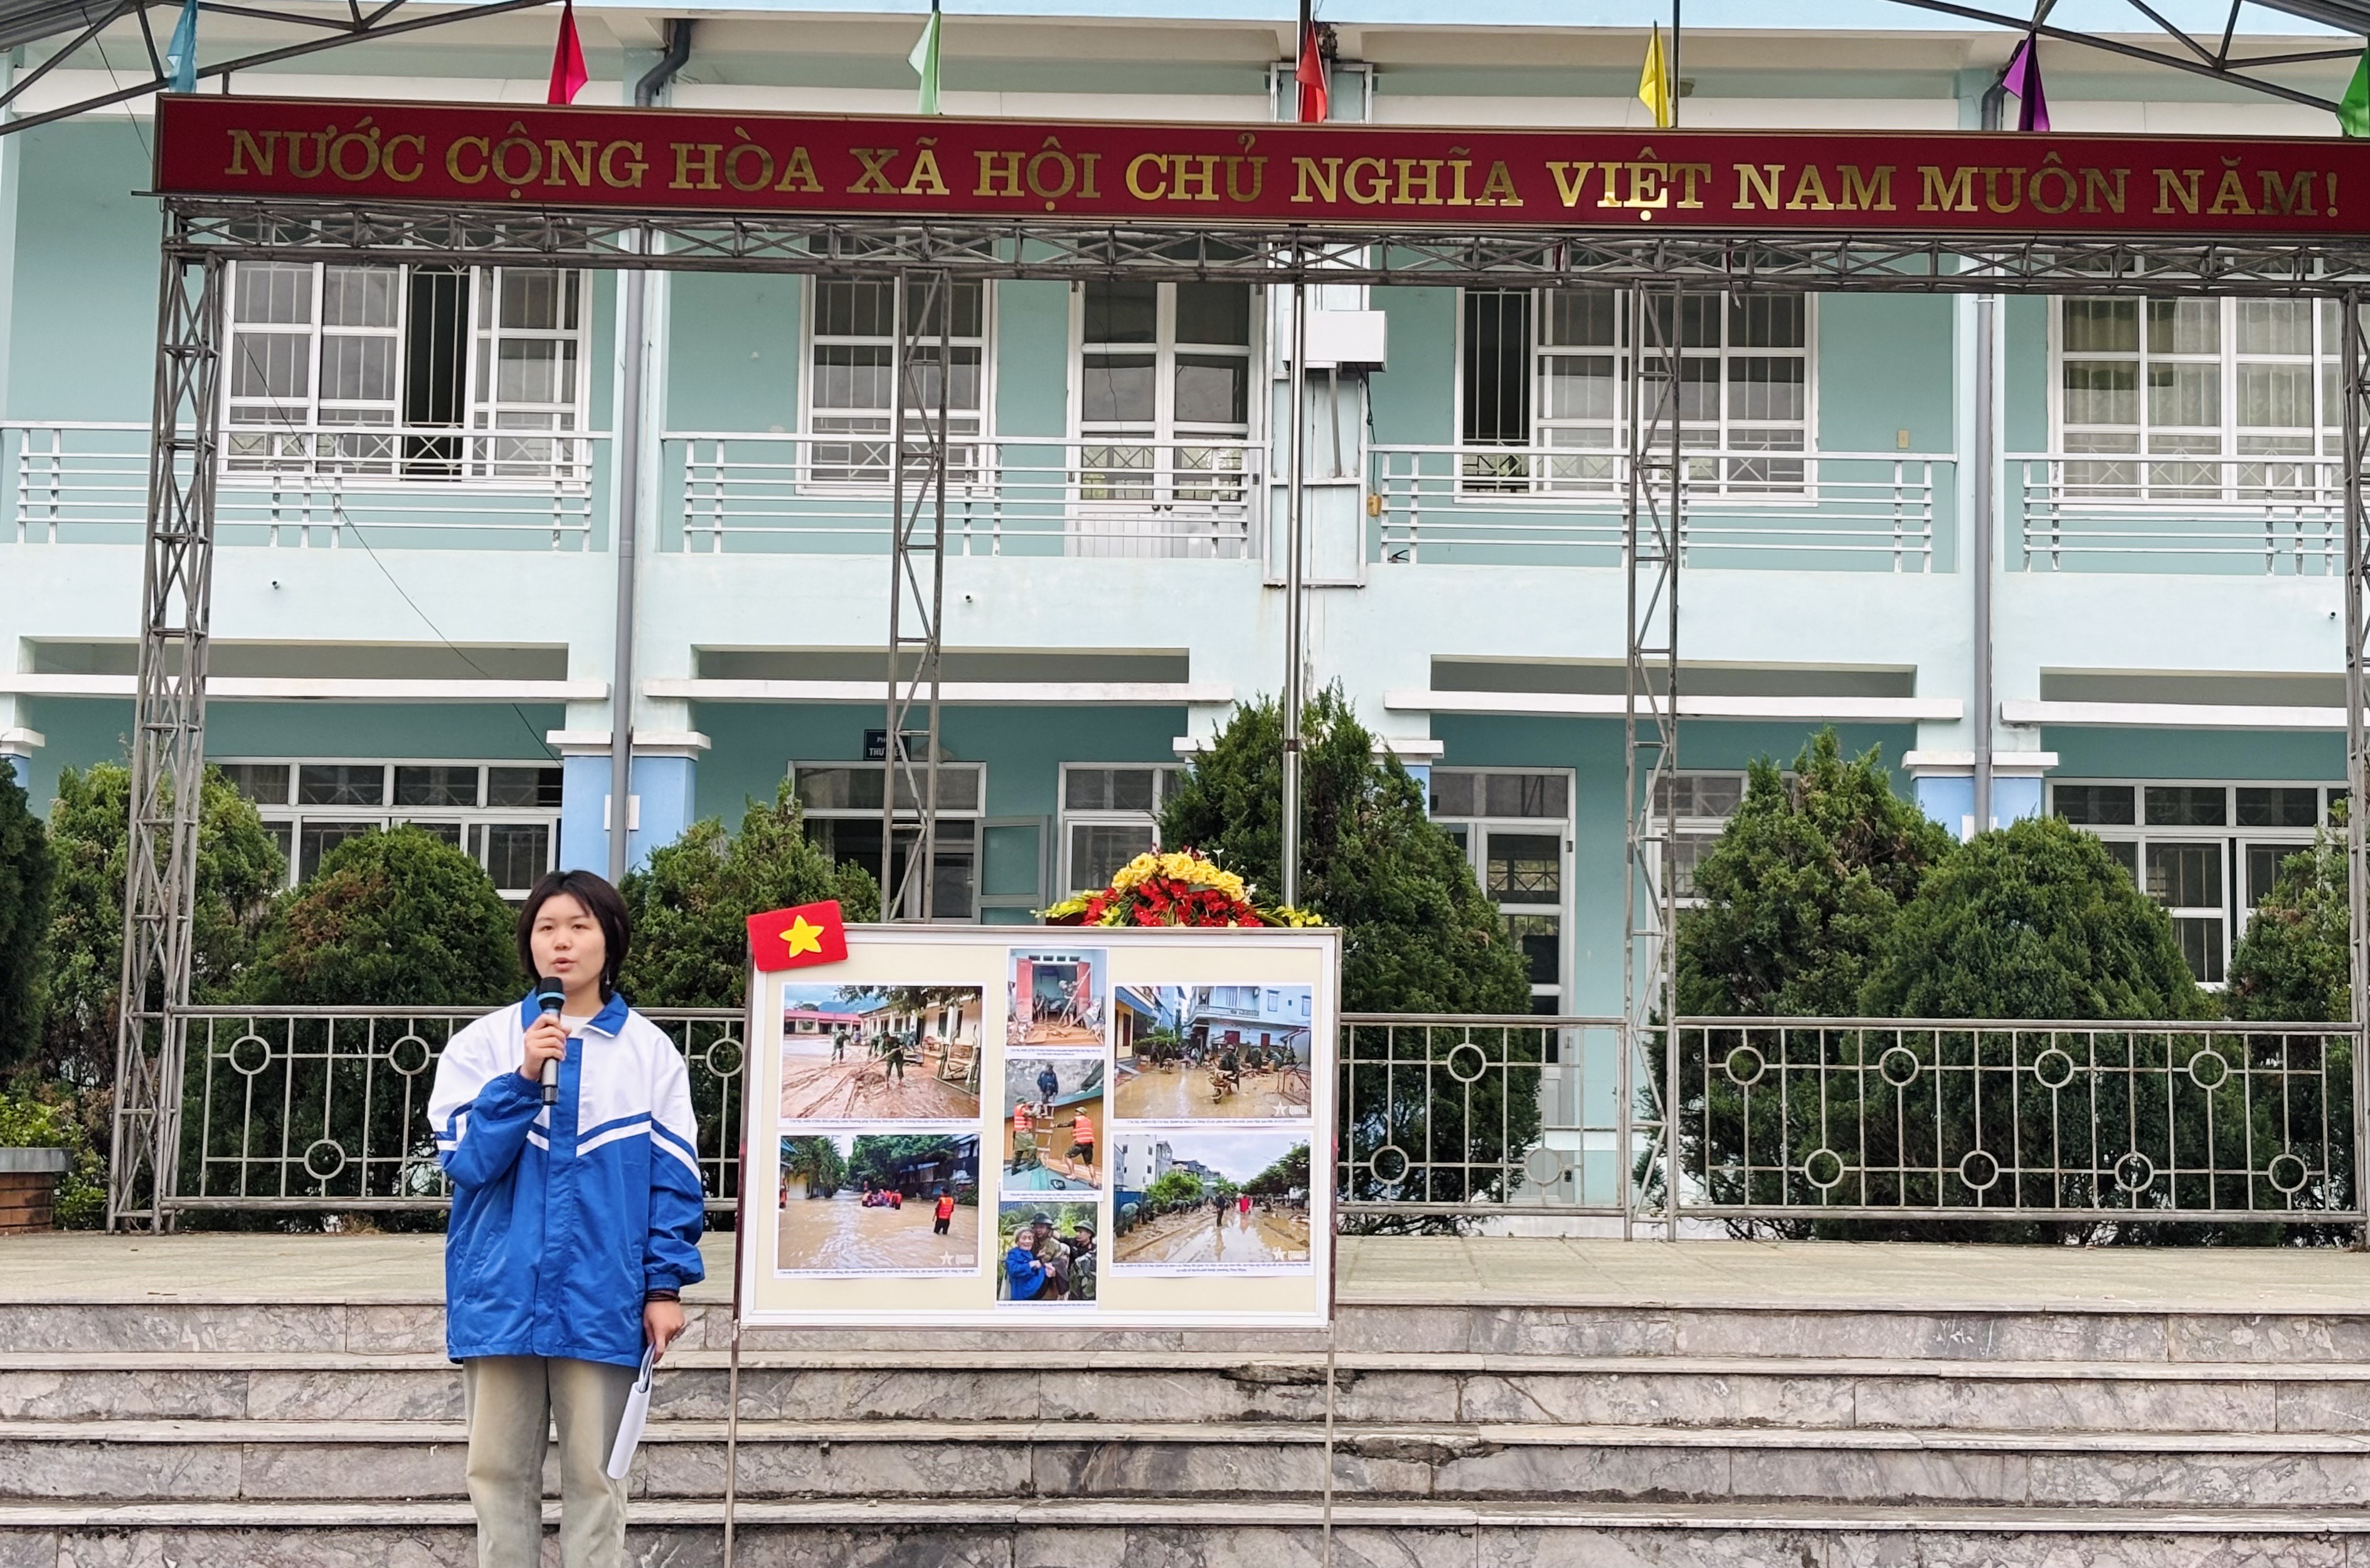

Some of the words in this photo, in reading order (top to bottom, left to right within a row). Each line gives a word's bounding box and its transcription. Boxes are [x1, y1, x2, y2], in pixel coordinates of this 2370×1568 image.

[225, 117, 425, 182] NƯỚC
[446, 121, 649, 198] CỘNG
[669, 126, 824, 192] HÒA
[846, 136, 950, 195] XÃ
[974, 135, 1102, 211] HỘI
[1125, 132, 1268, 202] CHỦ
[1291, 146, 1524, 208] NGHĨA
[1546, 147, 1711, 221] VIỆT
[1732, 164, 1897, 211] NAM
[1917, 151, 2131, 214] MUÔN
[2152, 156, 2339, 217] NĂM!
